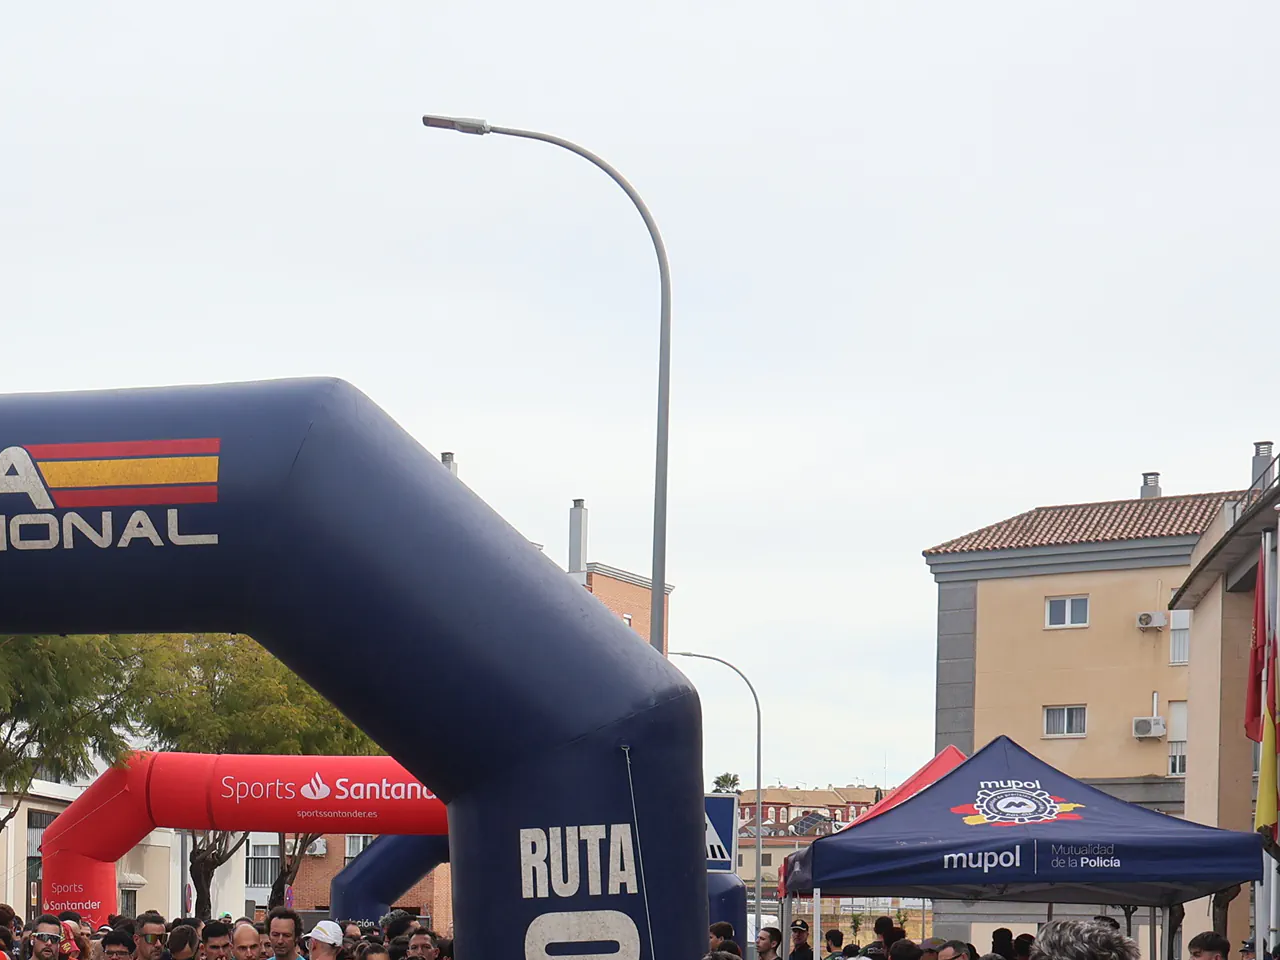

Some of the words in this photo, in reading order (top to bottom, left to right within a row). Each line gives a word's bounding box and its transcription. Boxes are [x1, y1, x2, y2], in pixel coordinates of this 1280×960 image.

[221, 776, 296, 804] Sports
[979, 780, 1041, 790] mupol
[297, 809, 378, 819] sportssantander.es
[1051, 843, 1115, 855] Mutualidad
[520, 823, 638, 899] RUTA
[943, 845, 1020, 873] mupol
[1051, 857, 1066, 868] de
[1068, 857, 1078, 868] la
[1080, 856, 1121, 868] Policía
[51, 883, 84, 895] Sports
[50, 900, 101, 911] Santander
